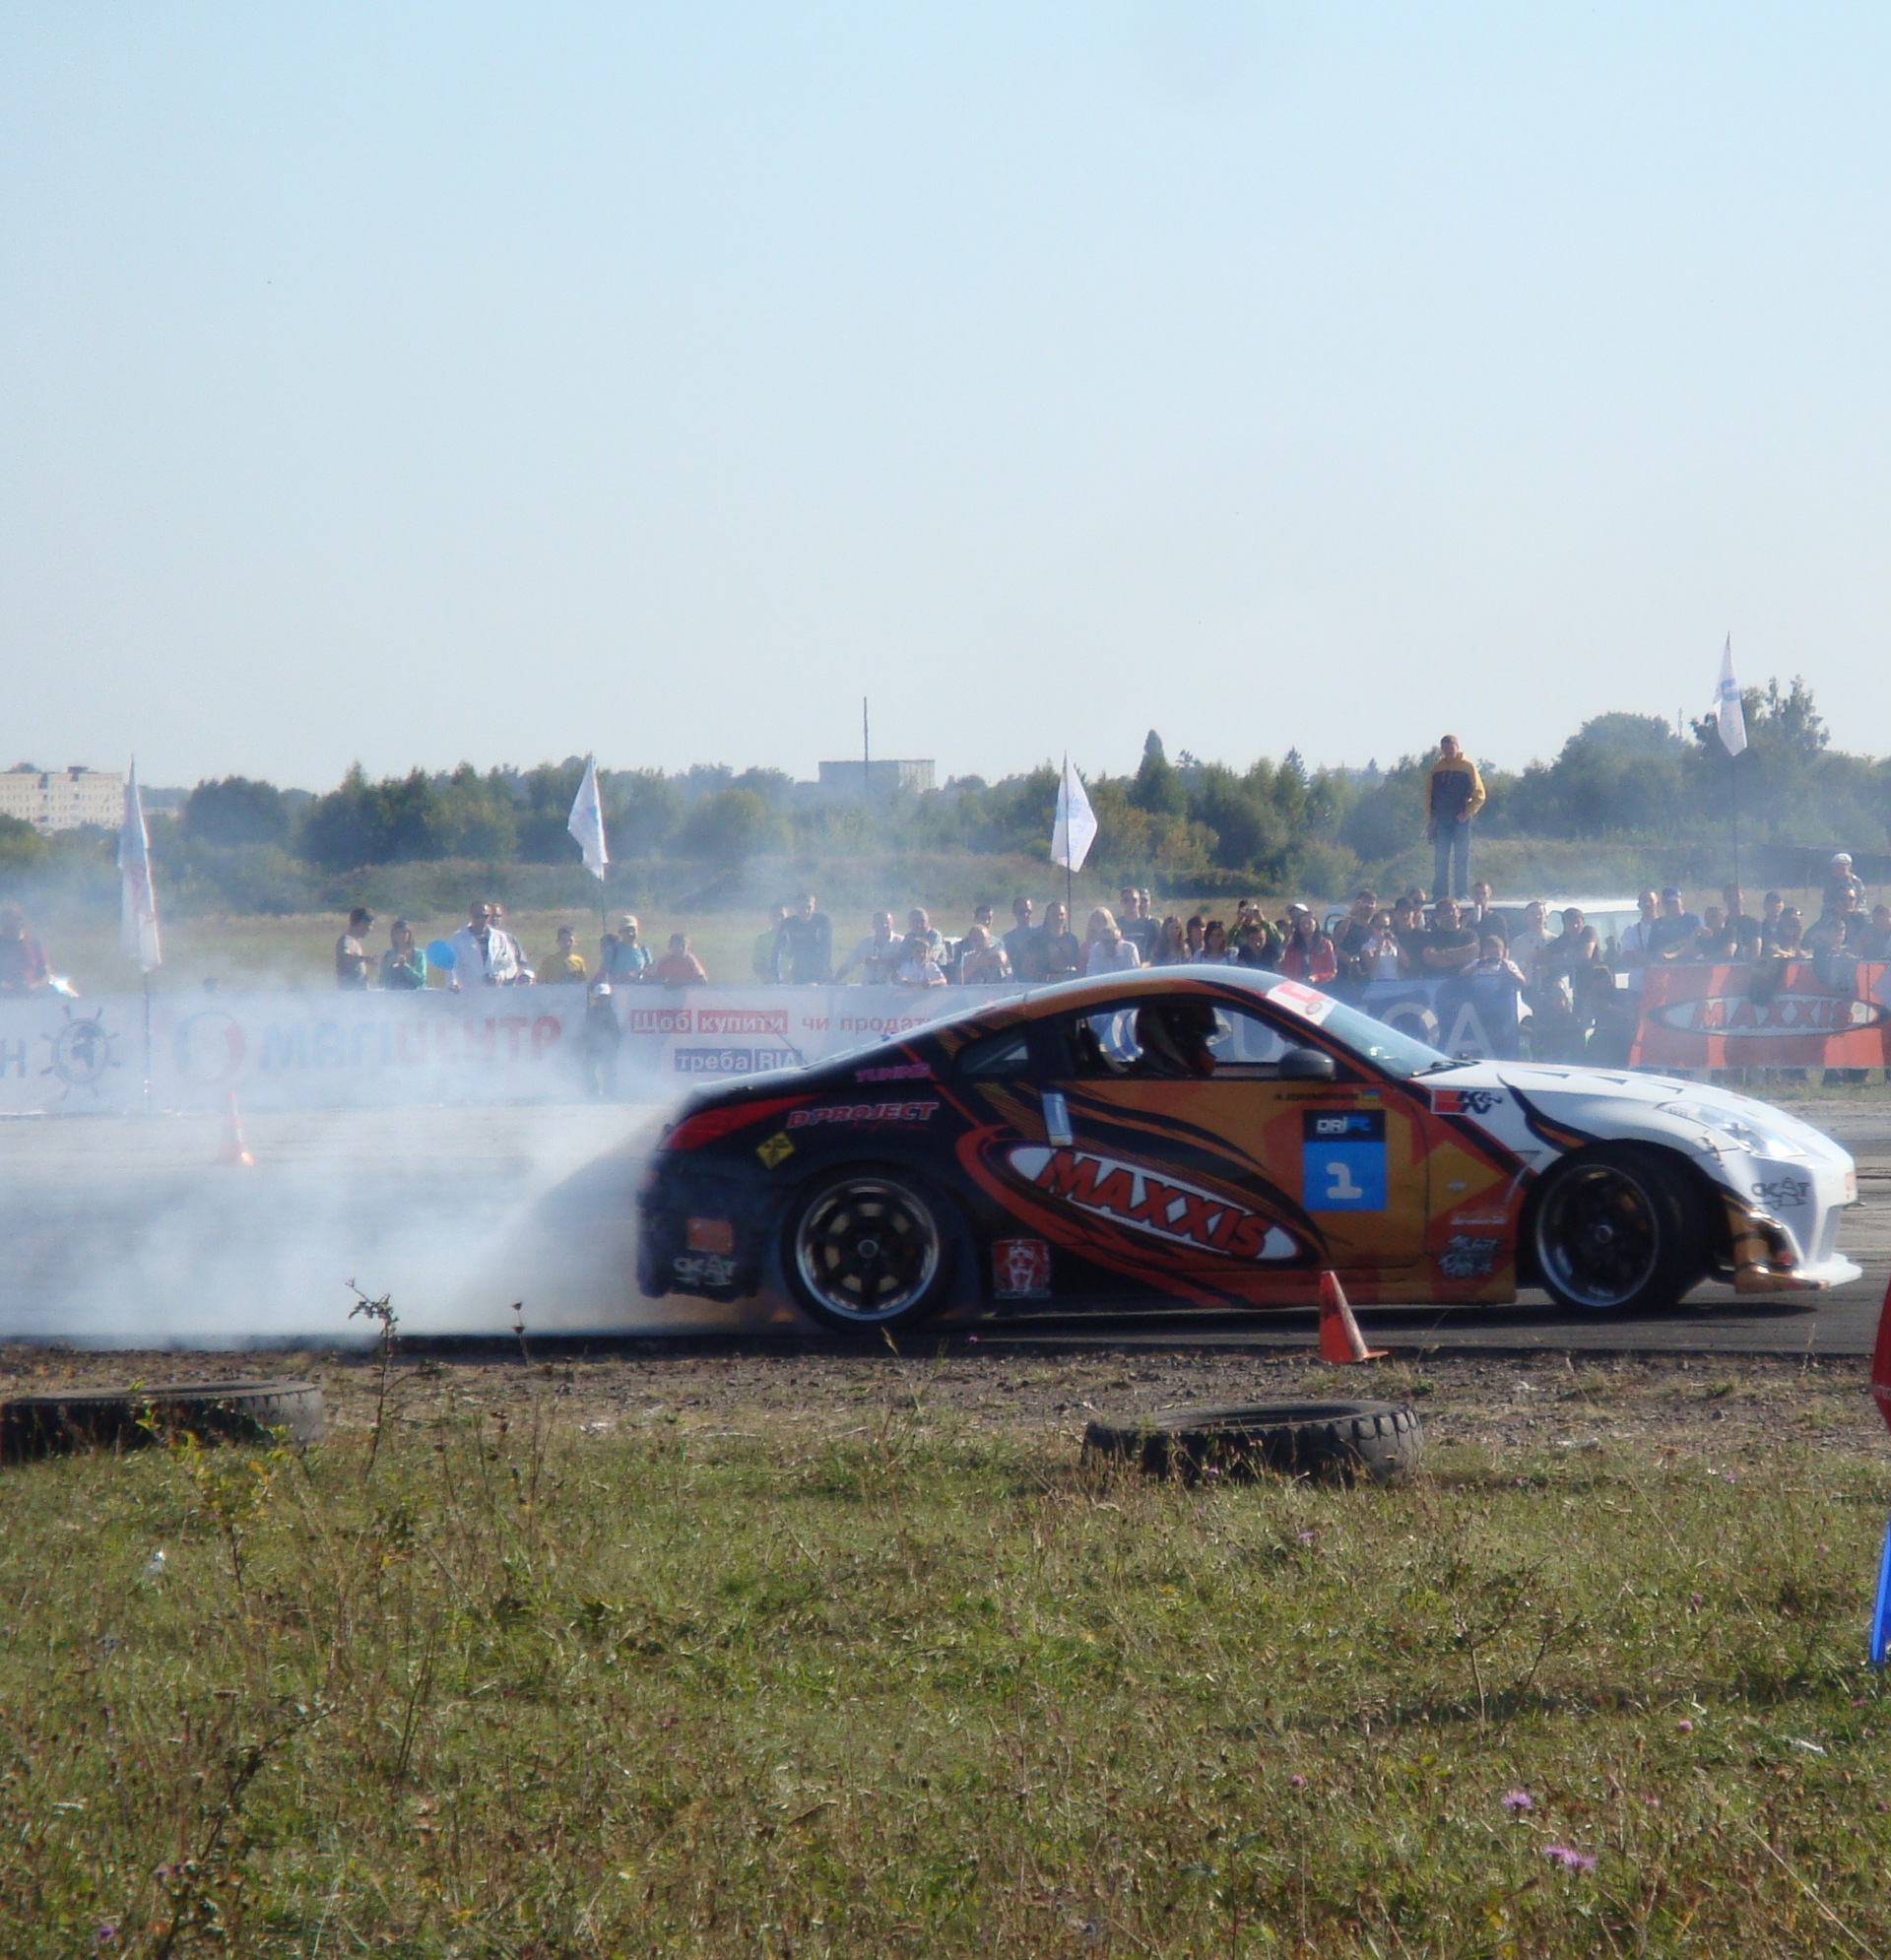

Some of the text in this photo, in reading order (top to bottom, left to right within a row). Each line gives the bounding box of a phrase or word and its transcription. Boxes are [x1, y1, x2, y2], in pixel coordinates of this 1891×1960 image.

[632, 1011, 931, 1035] Щоб купити чи продат
[1689, 999, 1855, 1030] MAXXIS
[677, 1050, 799, 1072] треба RIA
[1326, 1161, 1364, 1200] 1
[1034, 1148, 1272, 1259] MAXXIS
